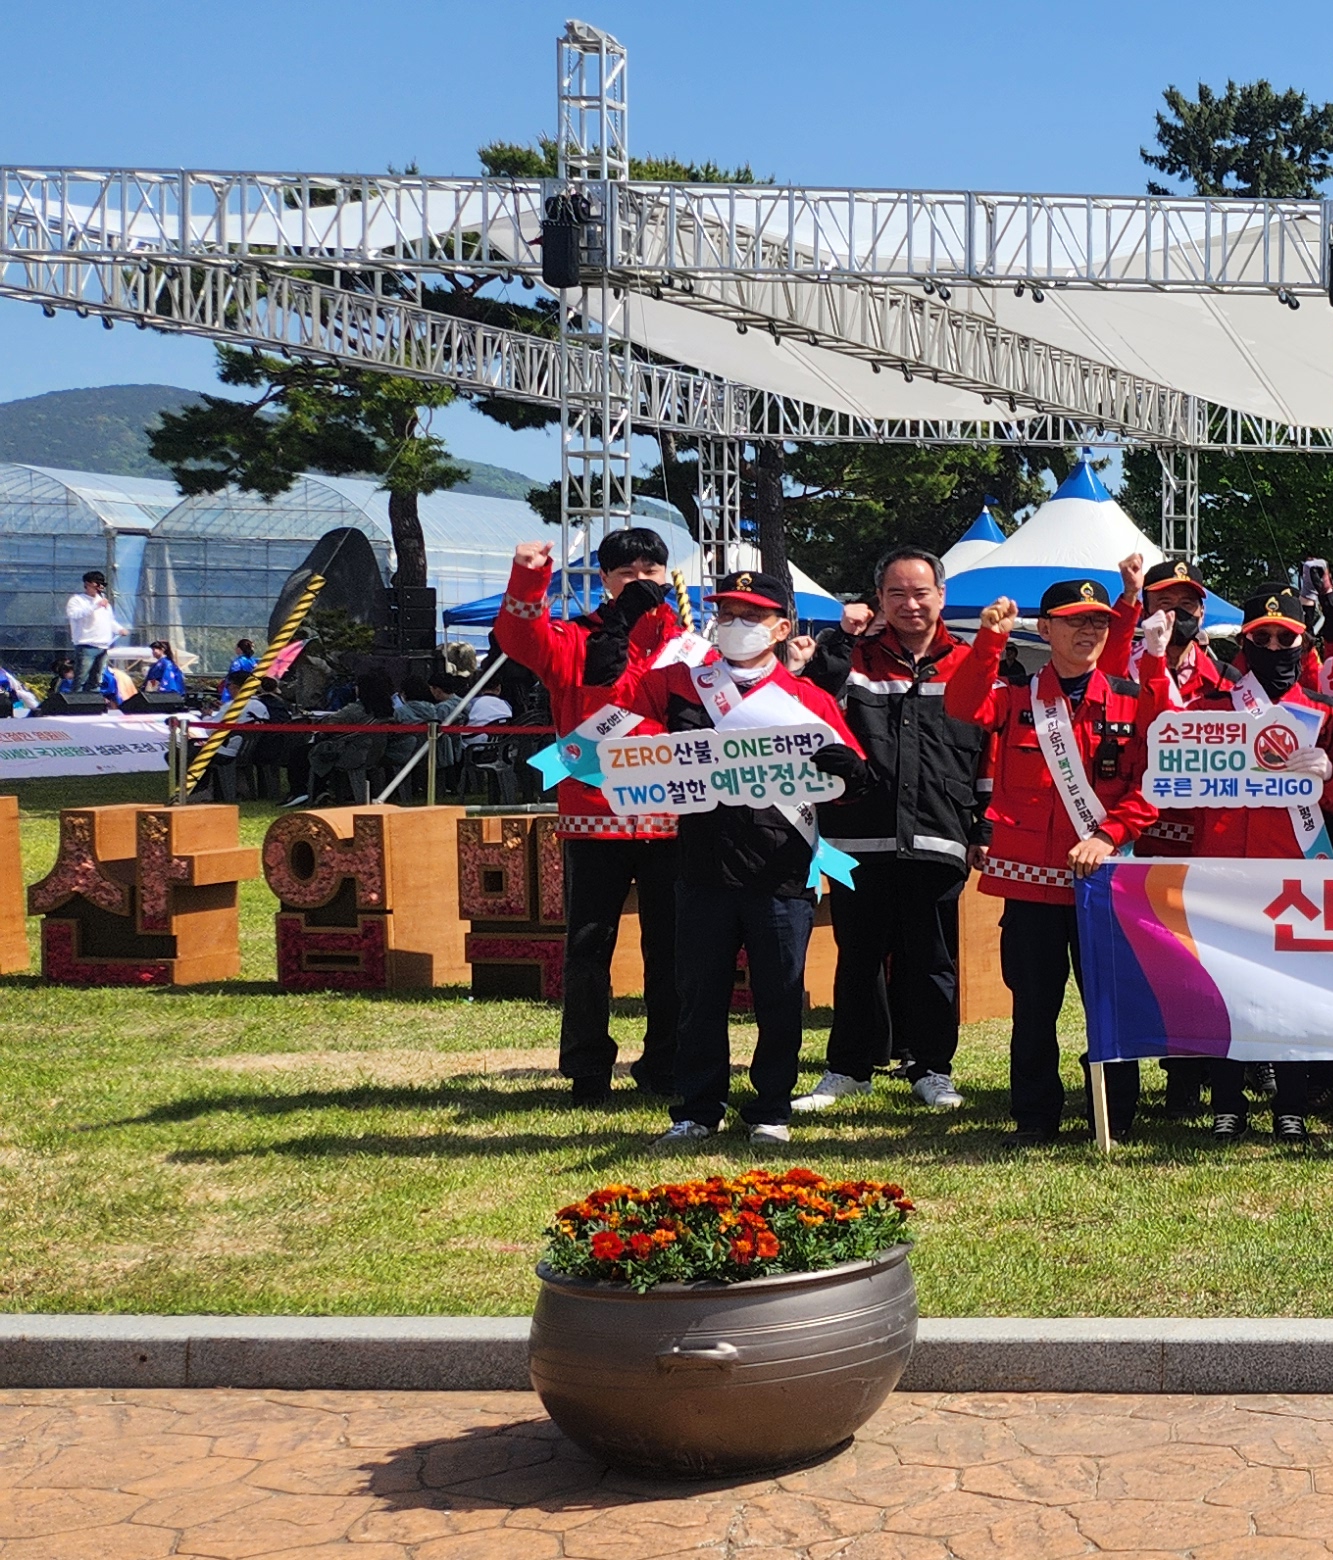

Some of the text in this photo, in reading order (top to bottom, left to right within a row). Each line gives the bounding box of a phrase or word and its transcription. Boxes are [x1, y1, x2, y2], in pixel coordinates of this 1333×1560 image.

[1158, 722, 1247, 744] 소각행위
[608, 732, 825, 769] ZERO산불, ONE하면?
[1159, 749, 1246, 773] 버리GO
[612, 763, 834, 807] TWO철한 예방정신!
[1153, 777, 1313, 798] 푸른 거제 누리GO
